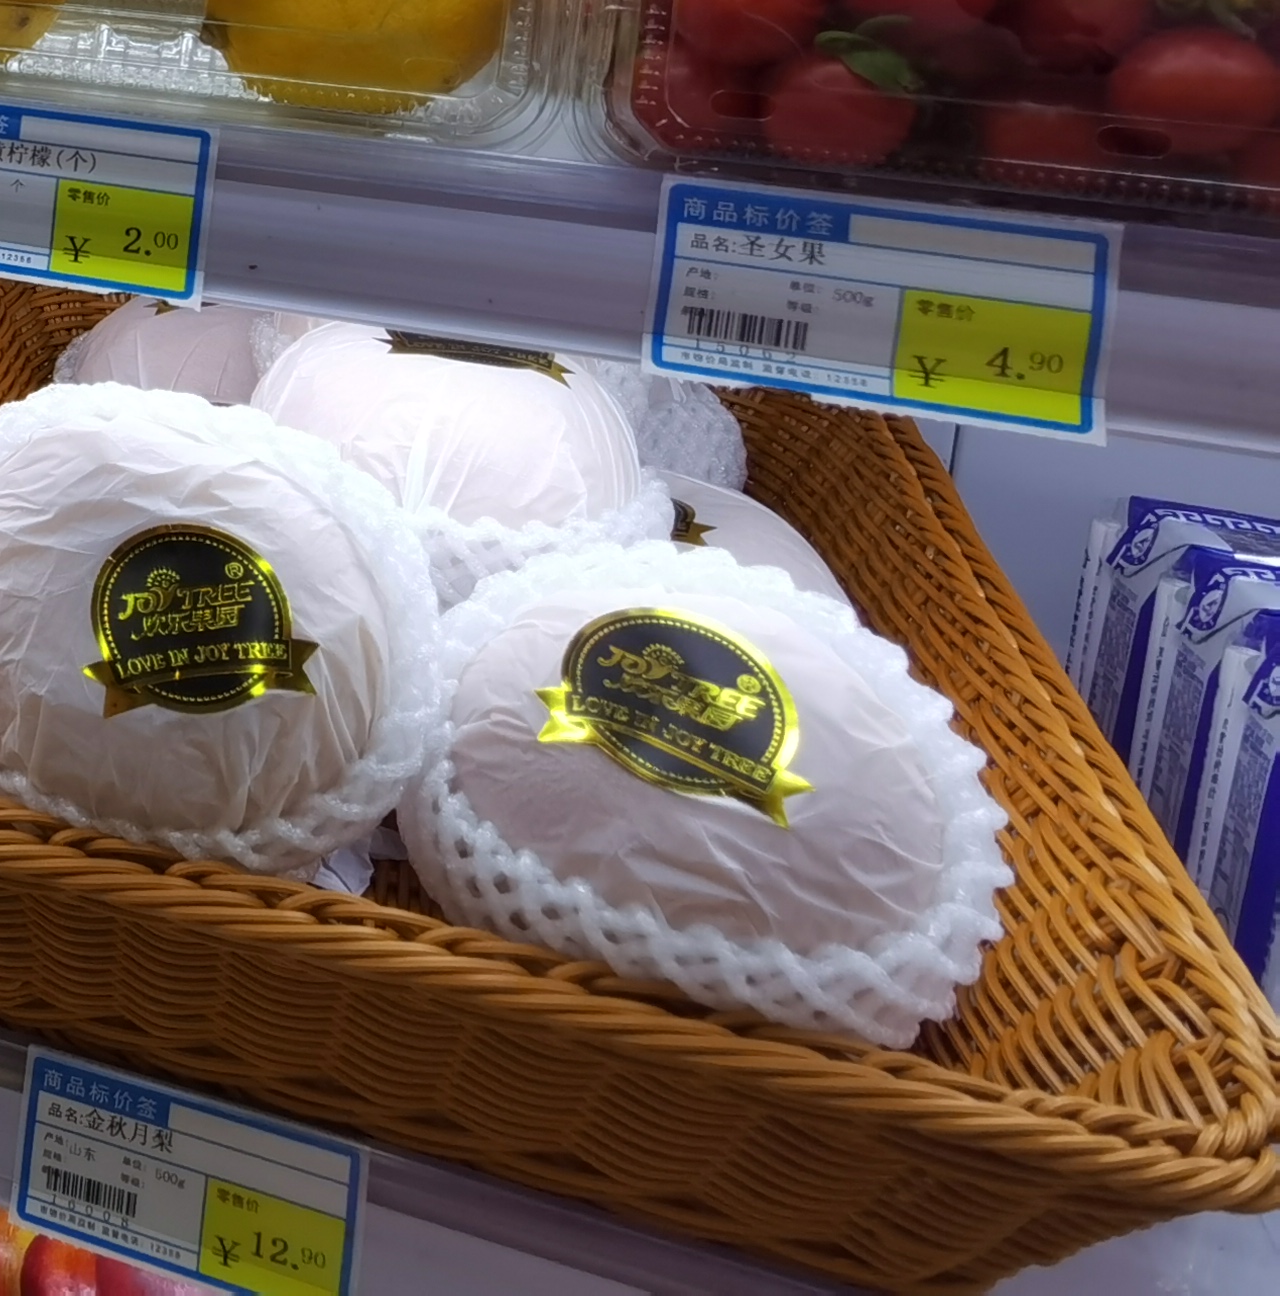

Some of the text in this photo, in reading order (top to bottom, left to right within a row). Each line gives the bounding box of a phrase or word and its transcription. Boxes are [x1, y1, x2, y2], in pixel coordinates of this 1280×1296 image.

[10, 179, 25, 193] 个
[67, 188, 112, 207] 零售价
[683, 197, 835, 237] 商品标价签
[122, 227, 180, 258] 2.00
[689, 232, 827, 266] 品名:圣女果
[916, 298, 976, 322] 零售价
[985, 346, 1064, 382] 4.90
[118, 580, 256, 621] JOY TREE
[117, 642, 288, 679] LOVE IN JOY TREE
[571, 695, 630, 725] LOVE
[661, 723, 708, 754] JOY
[708, 742, 773, 783] TREE
[43, 1068, 158, 1119] 商品标价签
[48, 1103, 174, 1154] 品名:金秋月梨
[69, 1143, 96, 1162] 山东
[216, 1187, 261, 1215] 零售价
[251, 1231, 327, 1272] 12.90
